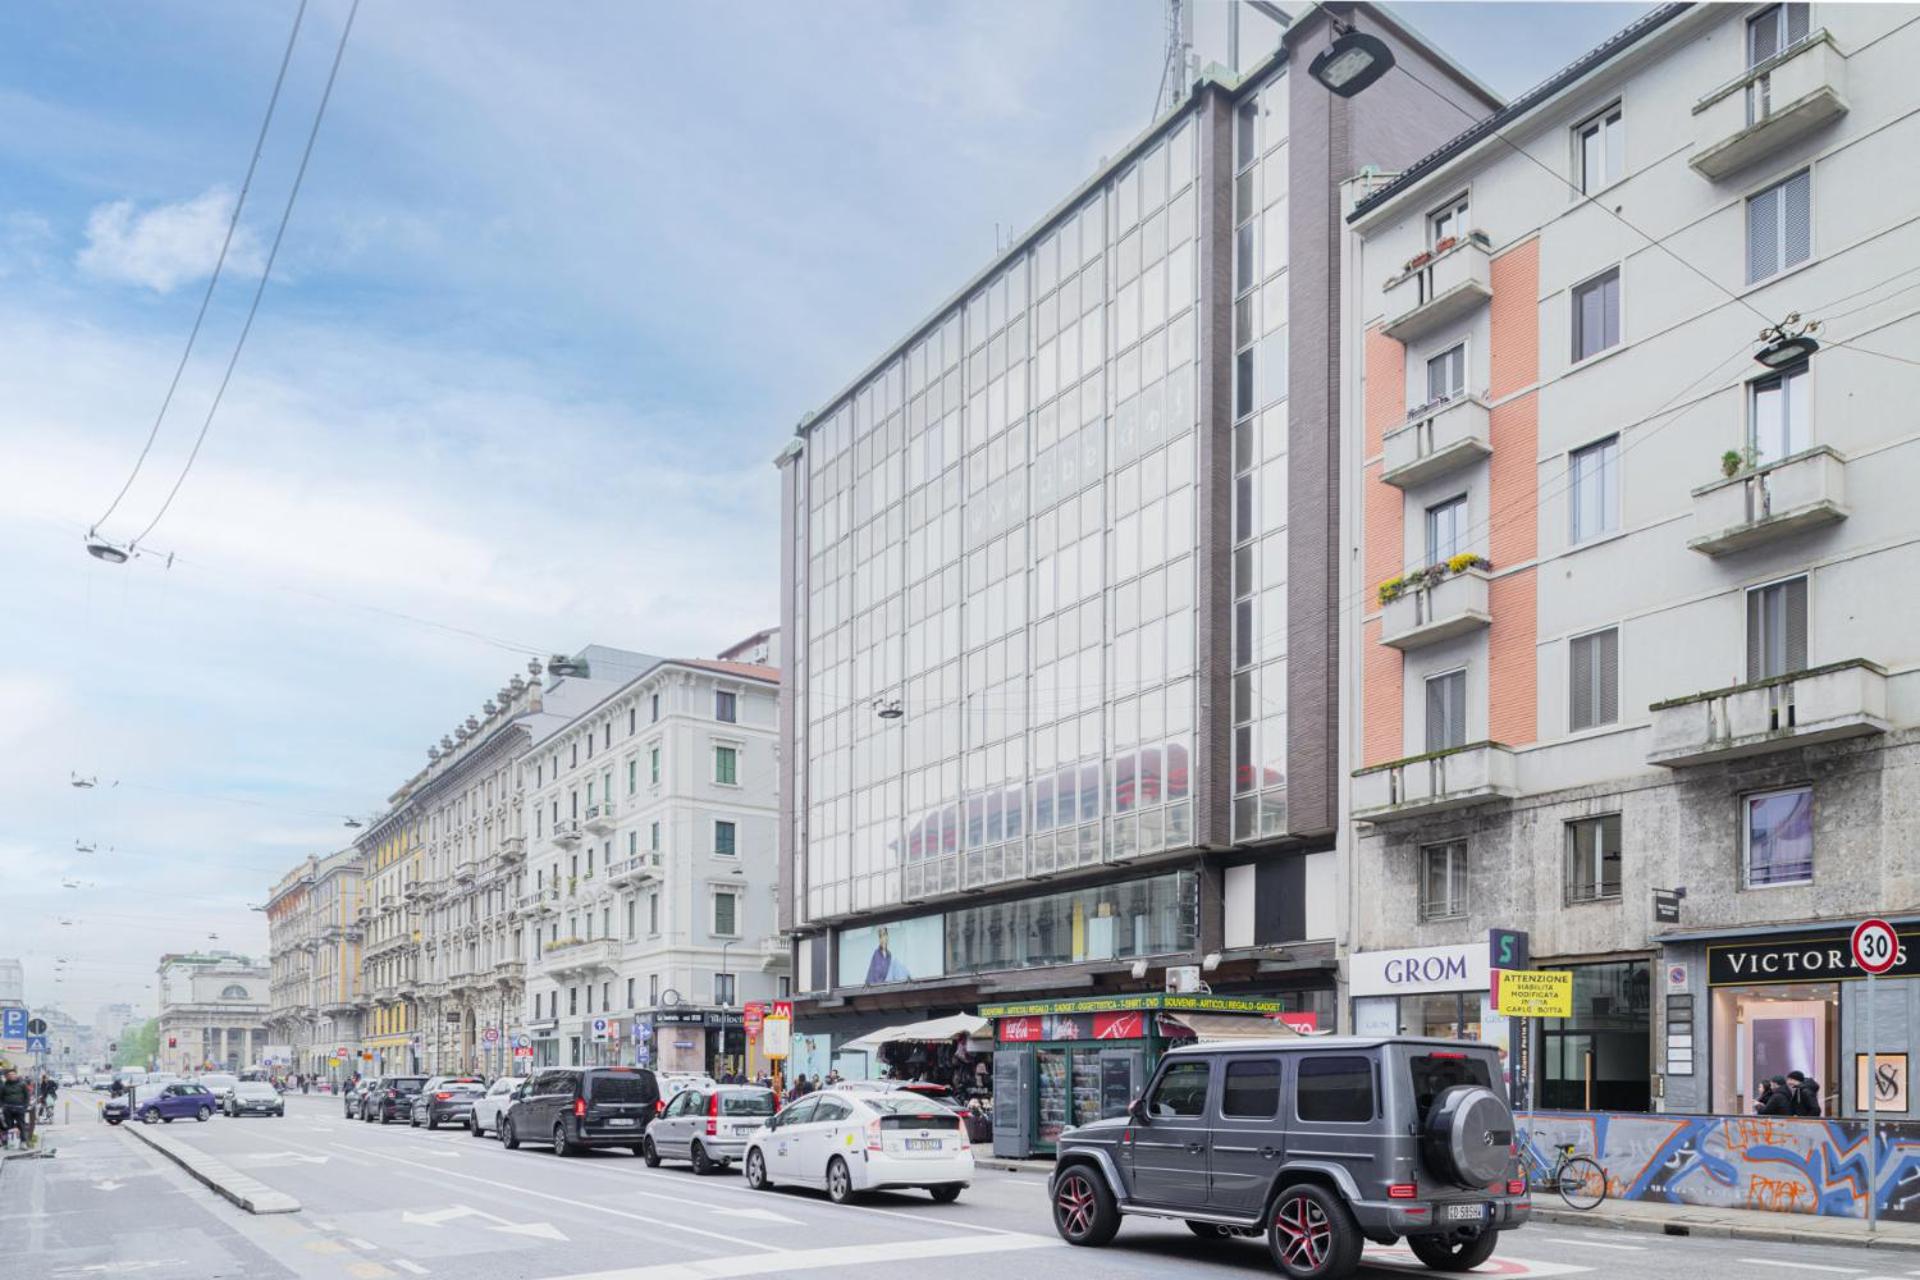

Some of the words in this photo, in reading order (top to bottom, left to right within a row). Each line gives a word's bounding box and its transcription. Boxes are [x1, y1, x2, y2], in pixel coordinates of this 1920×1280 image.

[1499, 935, 1515, 964] S
[1863, 934, 1888, 959] 30
[1384, 954, 1467, 984] GROM
[1503, 974, 1568, 984] ATTENZIONE
[1164, 997, 1197, 1009] SOUVENIR
[1226, 1000, 1254, 1011] REGALO
[1256, 1001, 1281, 1012] GADGET
[9, 1011, 21, 1026] P
